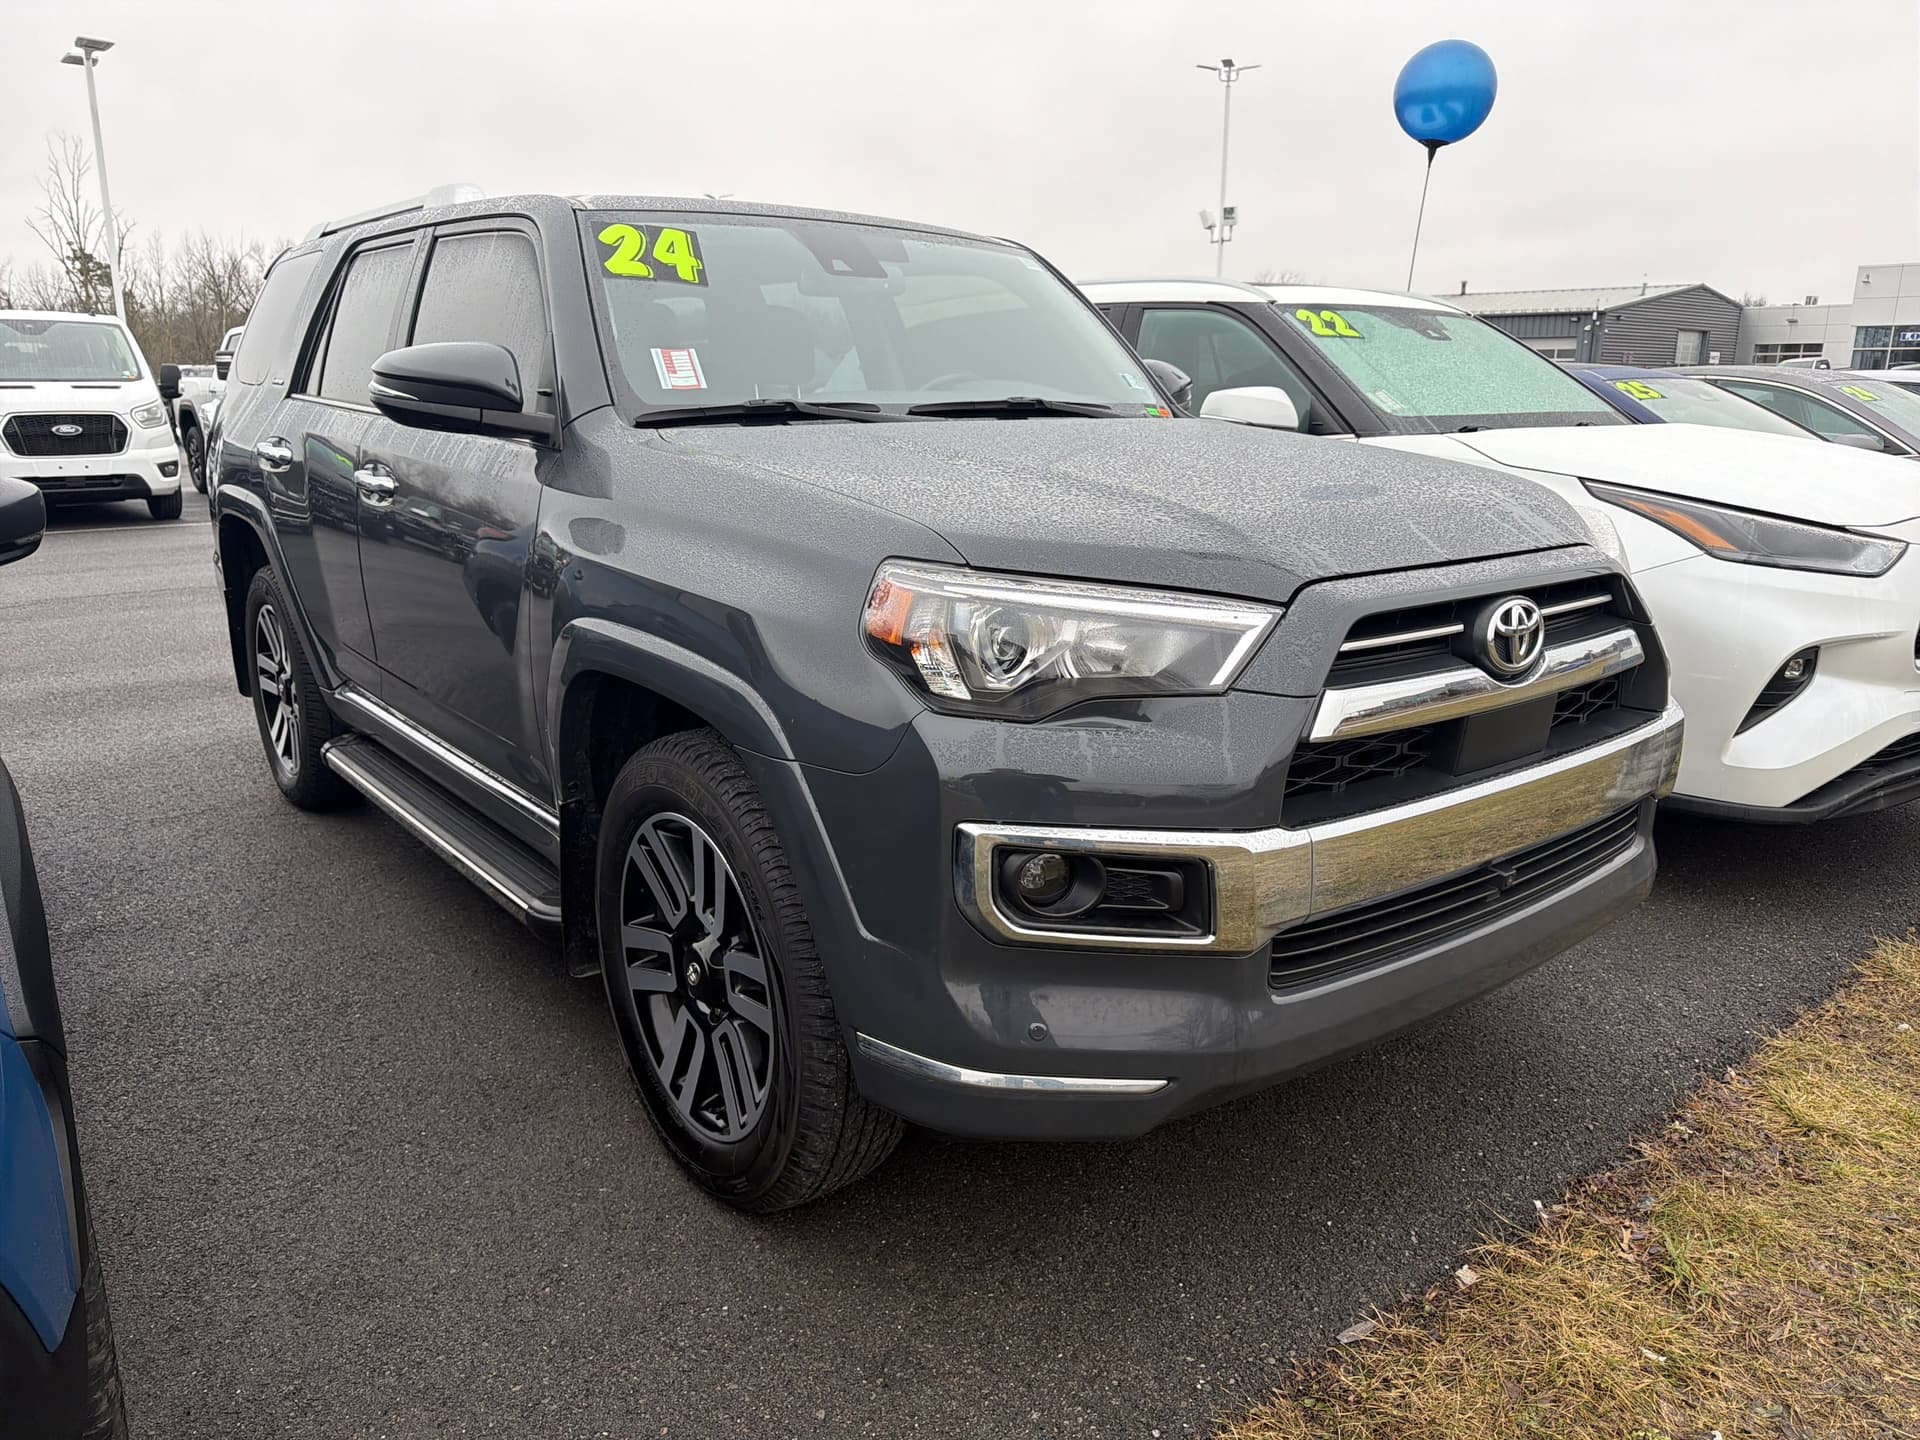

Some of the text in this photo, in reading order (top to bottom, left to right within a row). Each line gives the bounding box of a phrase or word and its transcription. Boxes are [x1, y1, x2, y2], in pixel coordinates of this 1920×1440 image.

[598, 223, 702, 284] 24
[1295, 308, 1362, 337] 22
[1615, 381, 1662, 399] 25
